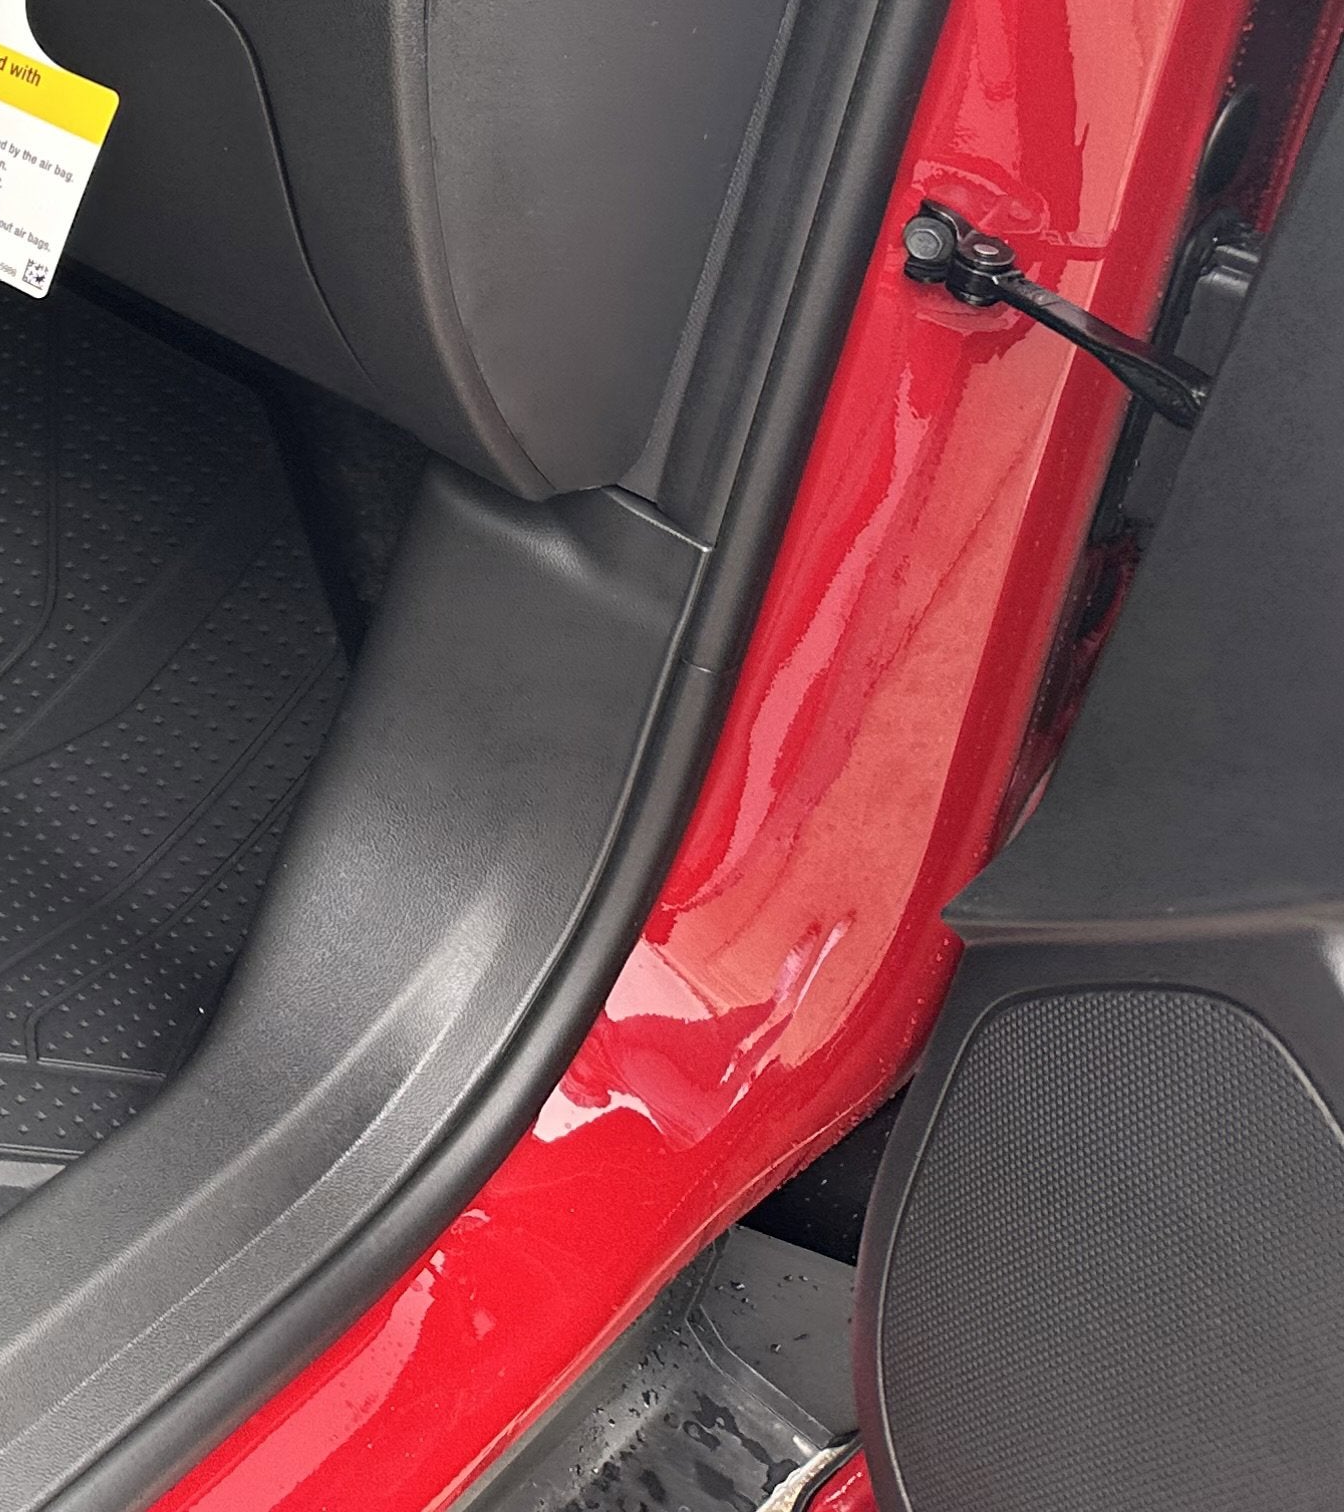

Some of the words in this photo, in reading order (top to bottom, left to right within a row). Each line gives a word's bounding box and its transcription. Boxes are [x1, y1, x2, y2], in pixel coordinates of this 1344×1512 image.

[10, 63, 41, 86] with
[9, 143, 21, 158] by
[22, 150, 37, 164] the
[39, 160, 53, 171] air
[54, 164, 73, 183] bag.
[14, 228, 27, 238] air
[27, 232, 50, 252] bags.
